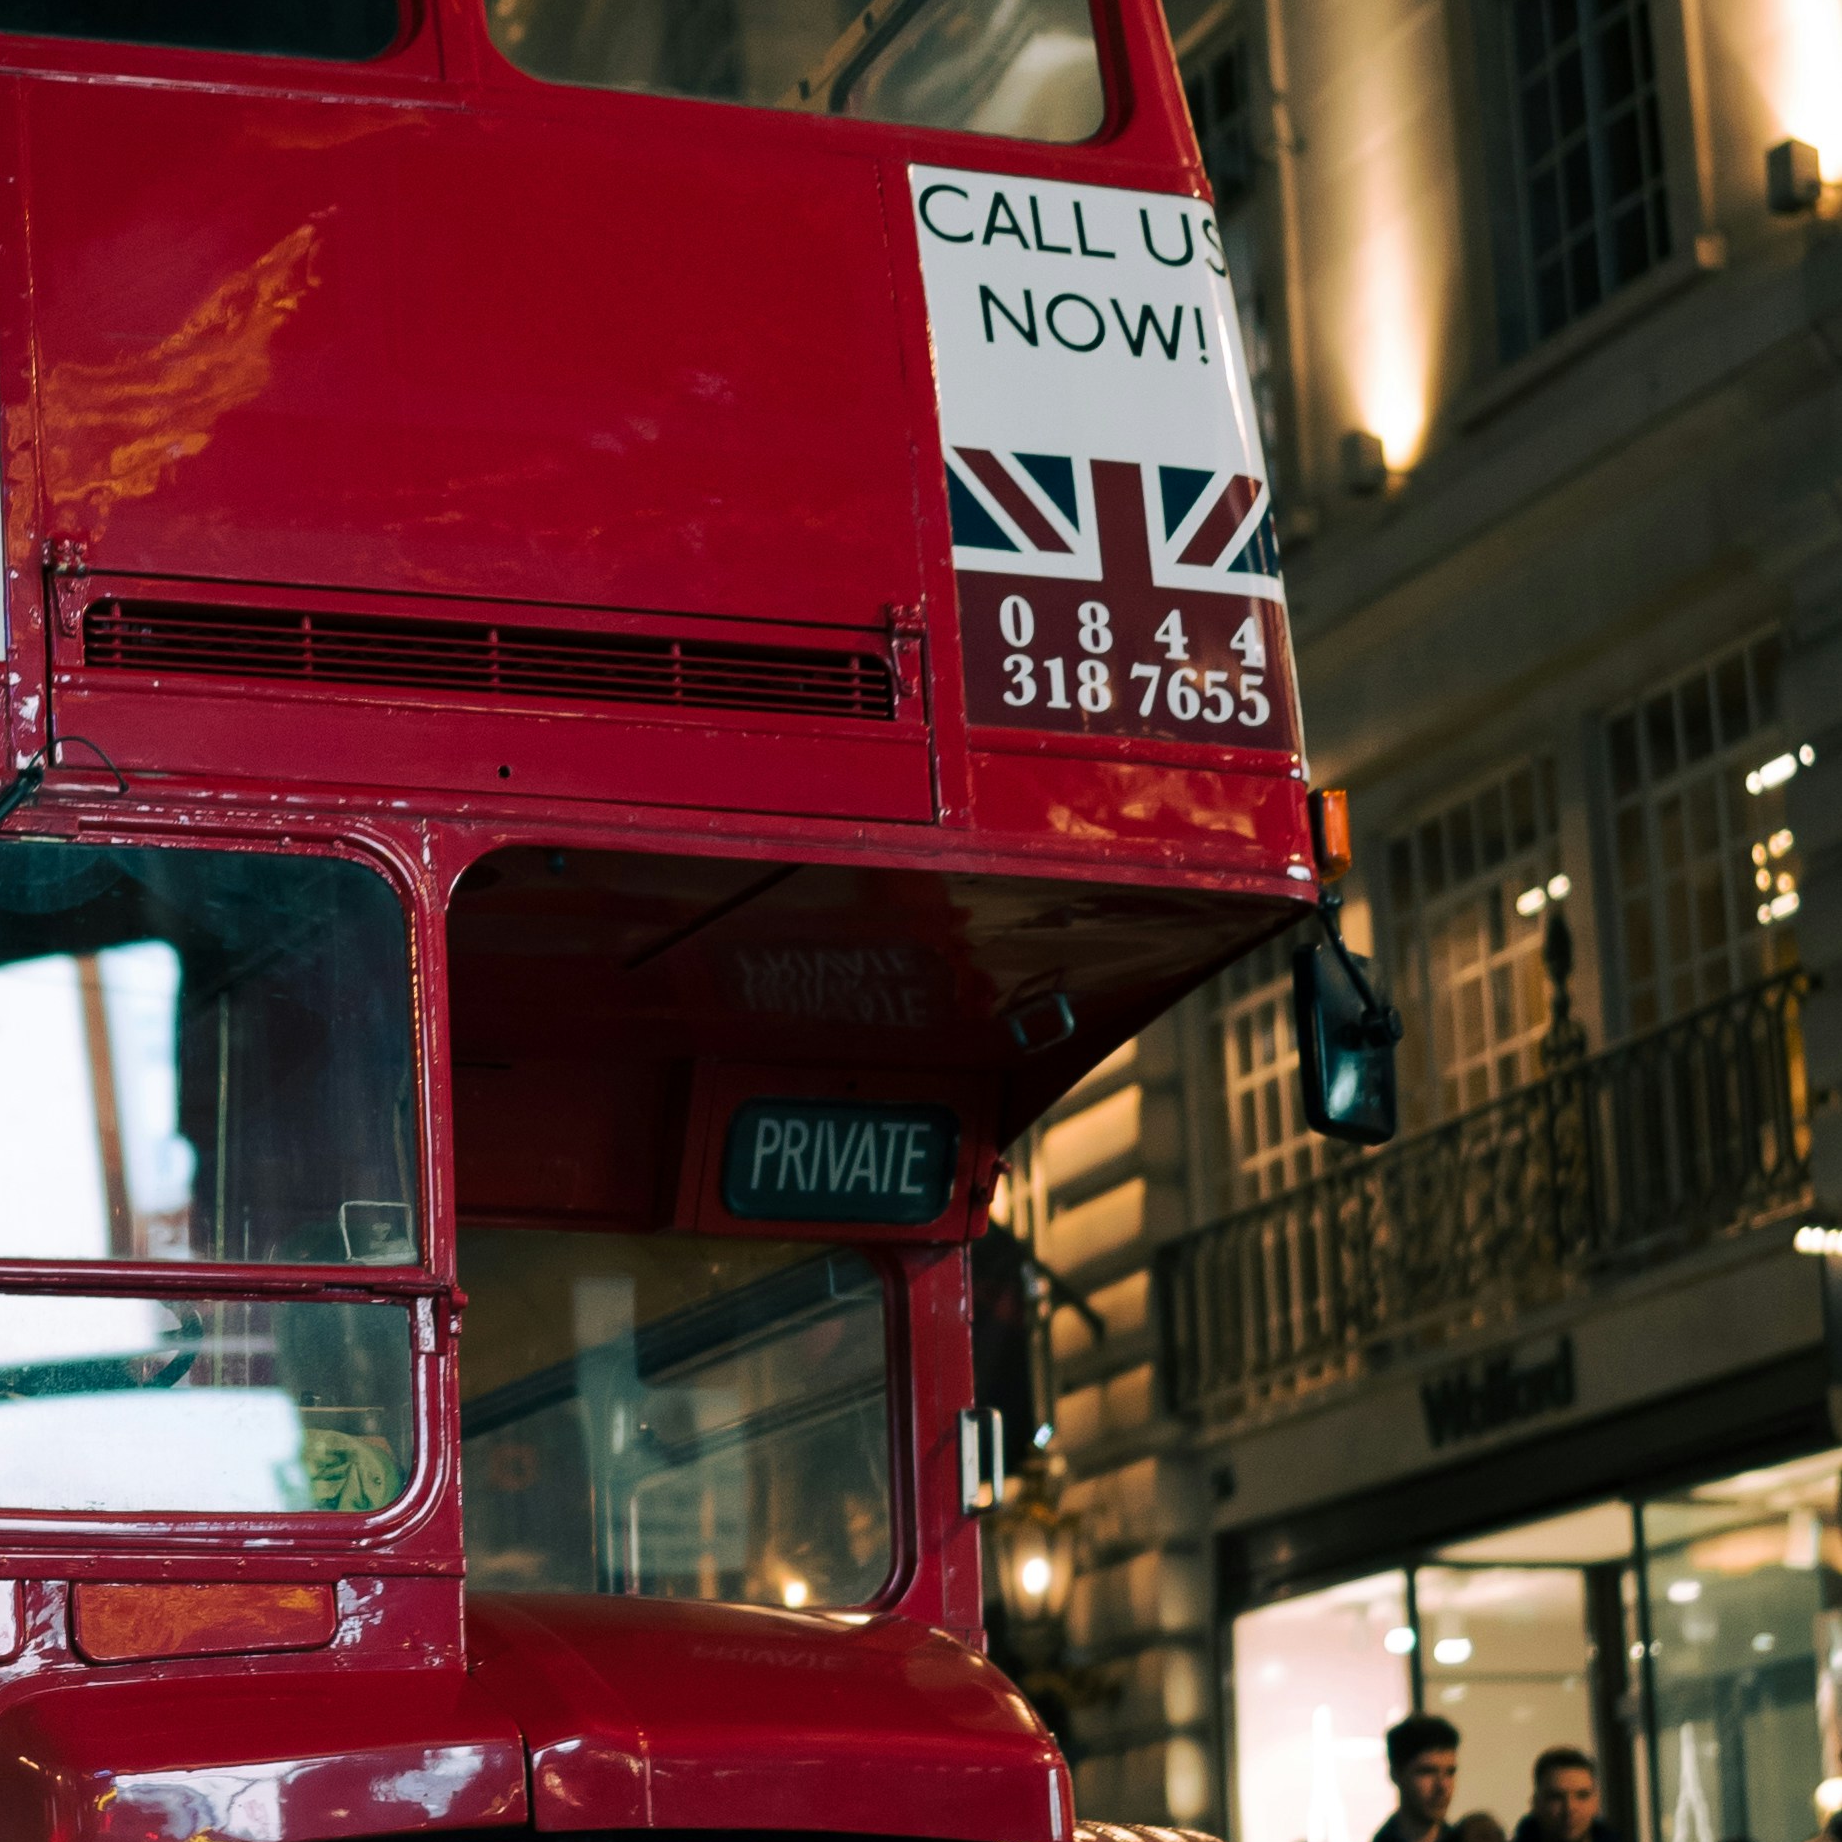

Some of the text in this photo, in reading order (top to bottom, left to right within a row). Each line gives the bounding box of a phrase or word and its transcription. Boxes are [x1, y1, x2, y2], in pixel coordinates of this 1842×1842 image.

[918, 184, 1230, 279] CALL US
[978, 284, 1209, 365] NOW!
[1001, 652, 1270, 728] 318 7655
[749, 1117, 932, 1196] PRIVATE
